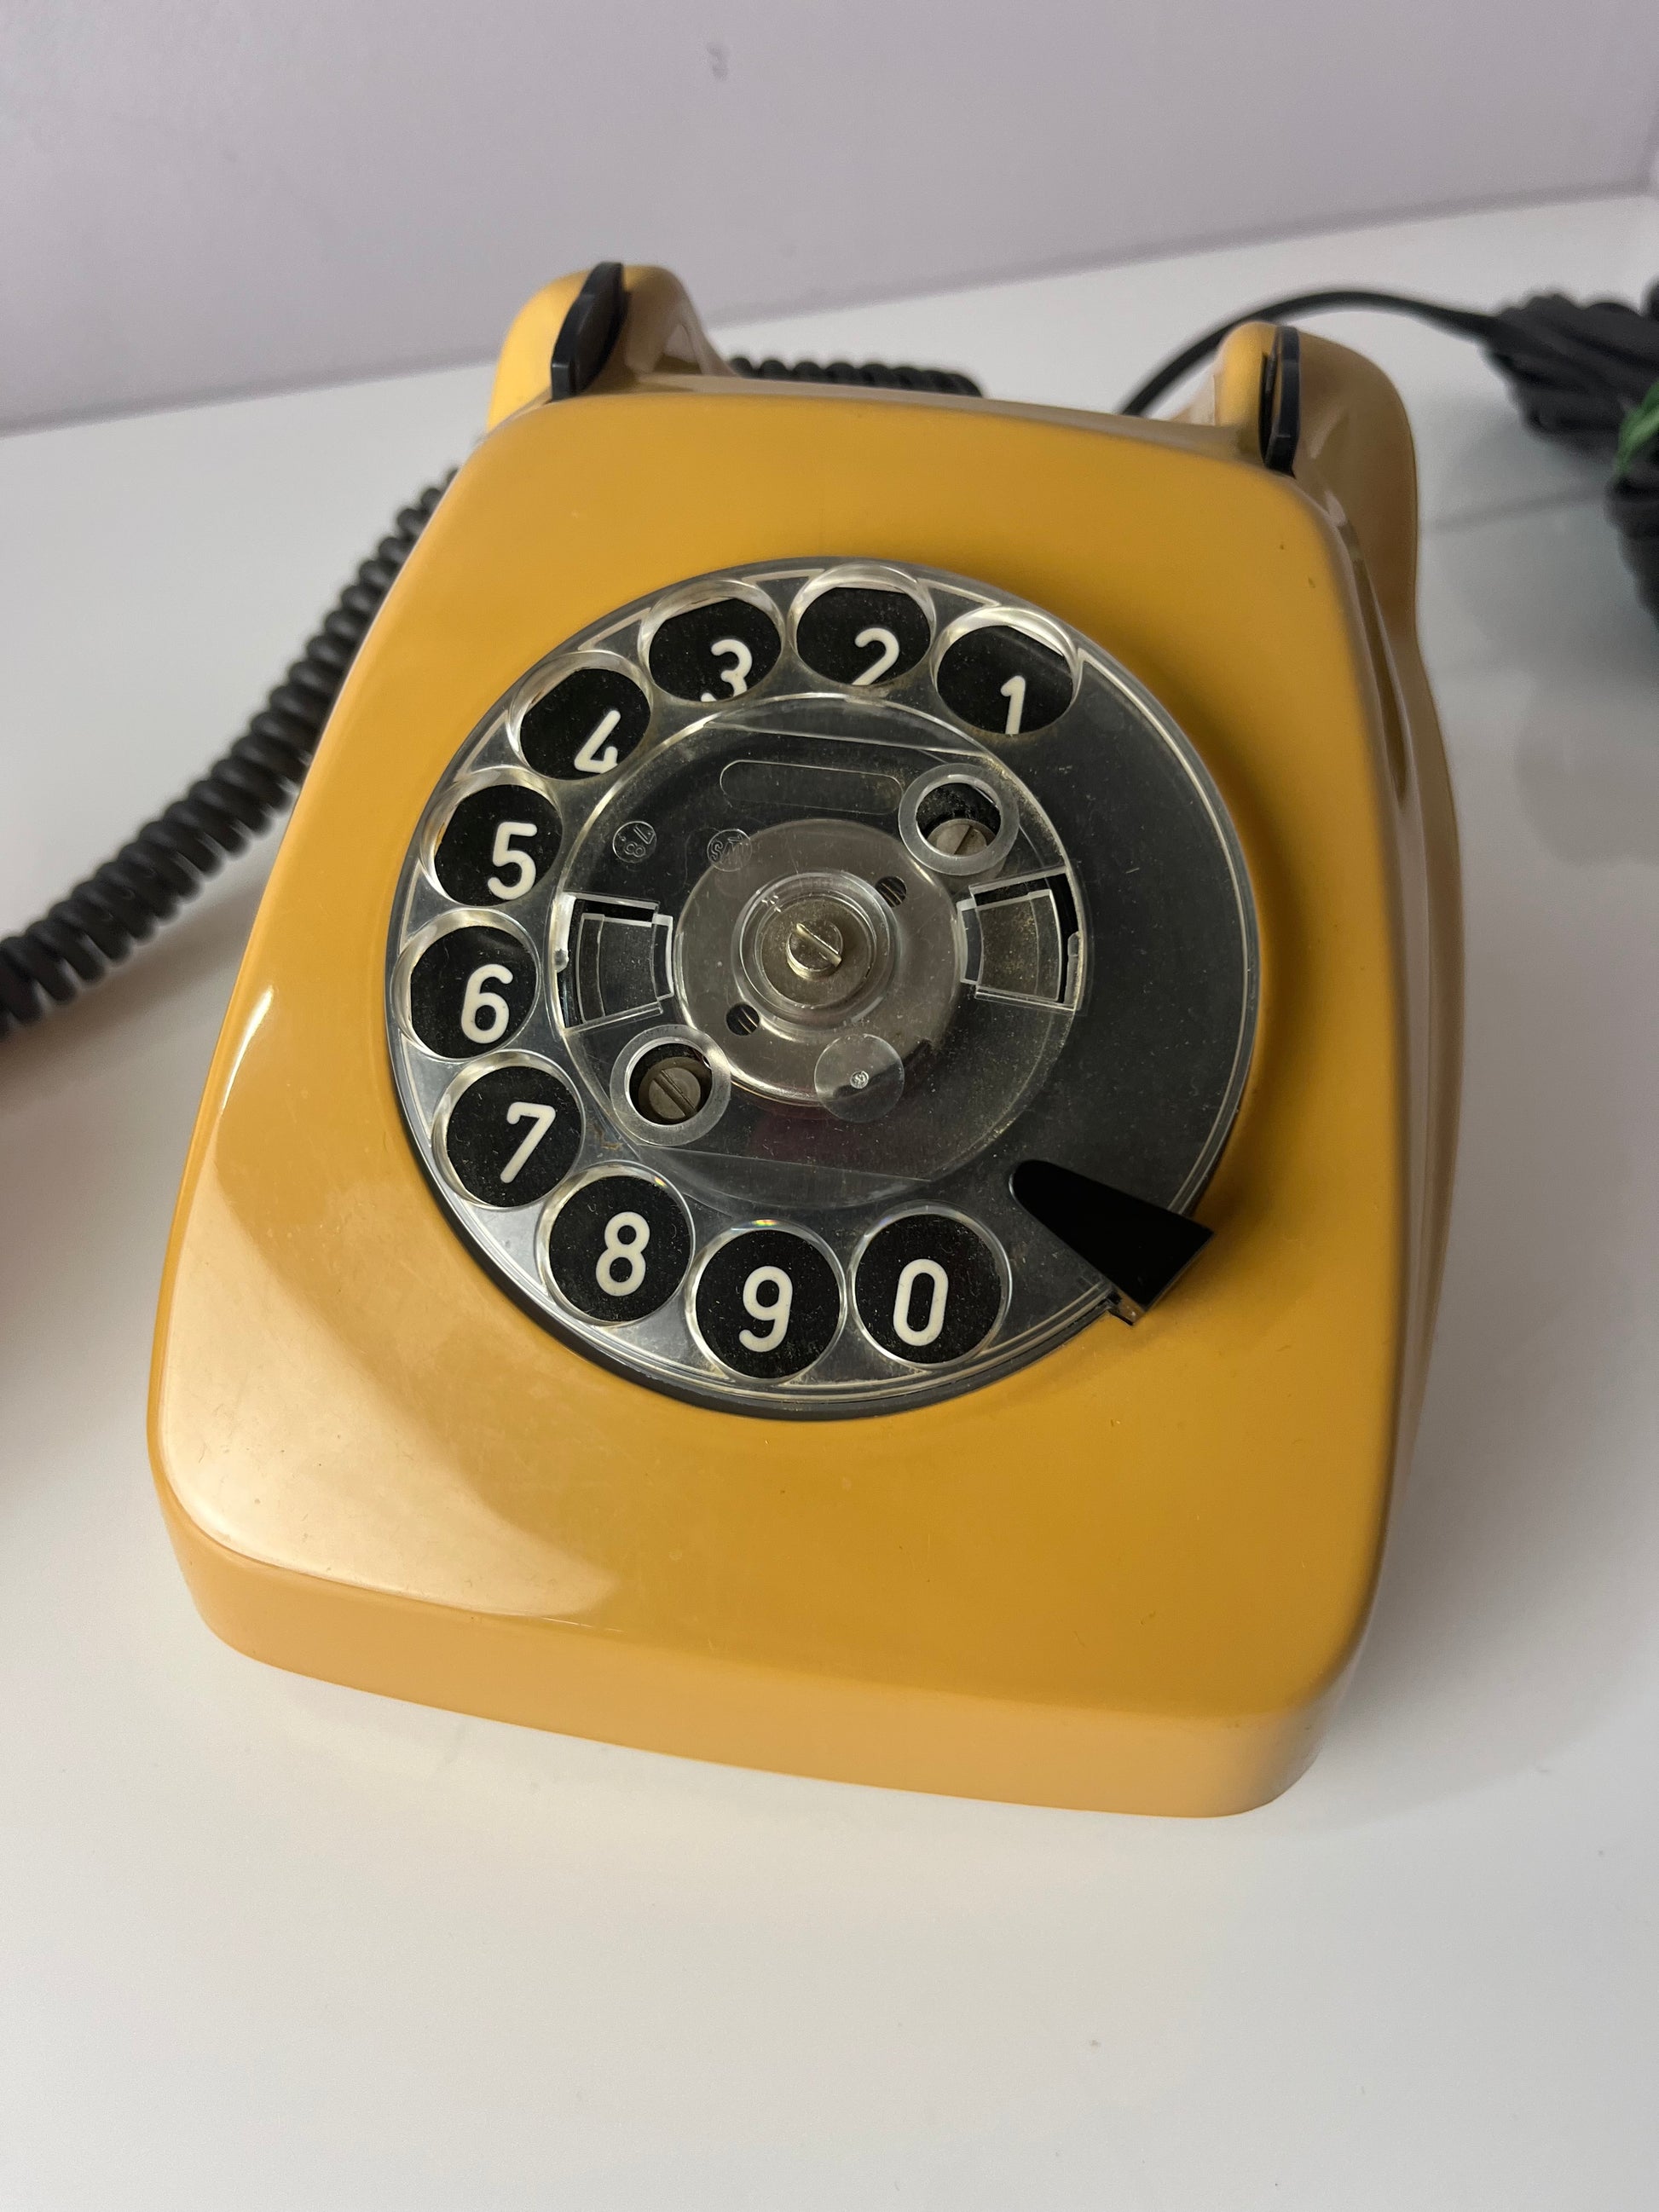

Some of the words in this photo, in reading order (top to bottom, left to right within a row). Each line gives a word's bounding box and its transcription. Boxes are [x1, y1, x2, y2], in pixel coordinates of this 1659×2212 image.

[701, 639, 752, 702] 3
[853, 628, 899, 685] 2
[575, 710, 620, 773] 4
[1001, 676, 1025, 735] 1
[488, 822, 537, 899] 5
[461, 964, 512, 1043] 6
[501, 1102, 555, 1182] 7
[596, 1212, 650, 1296] 8
[740, 1267, 792, 1352] 9
[893, 1259, 948, 1346] 0
